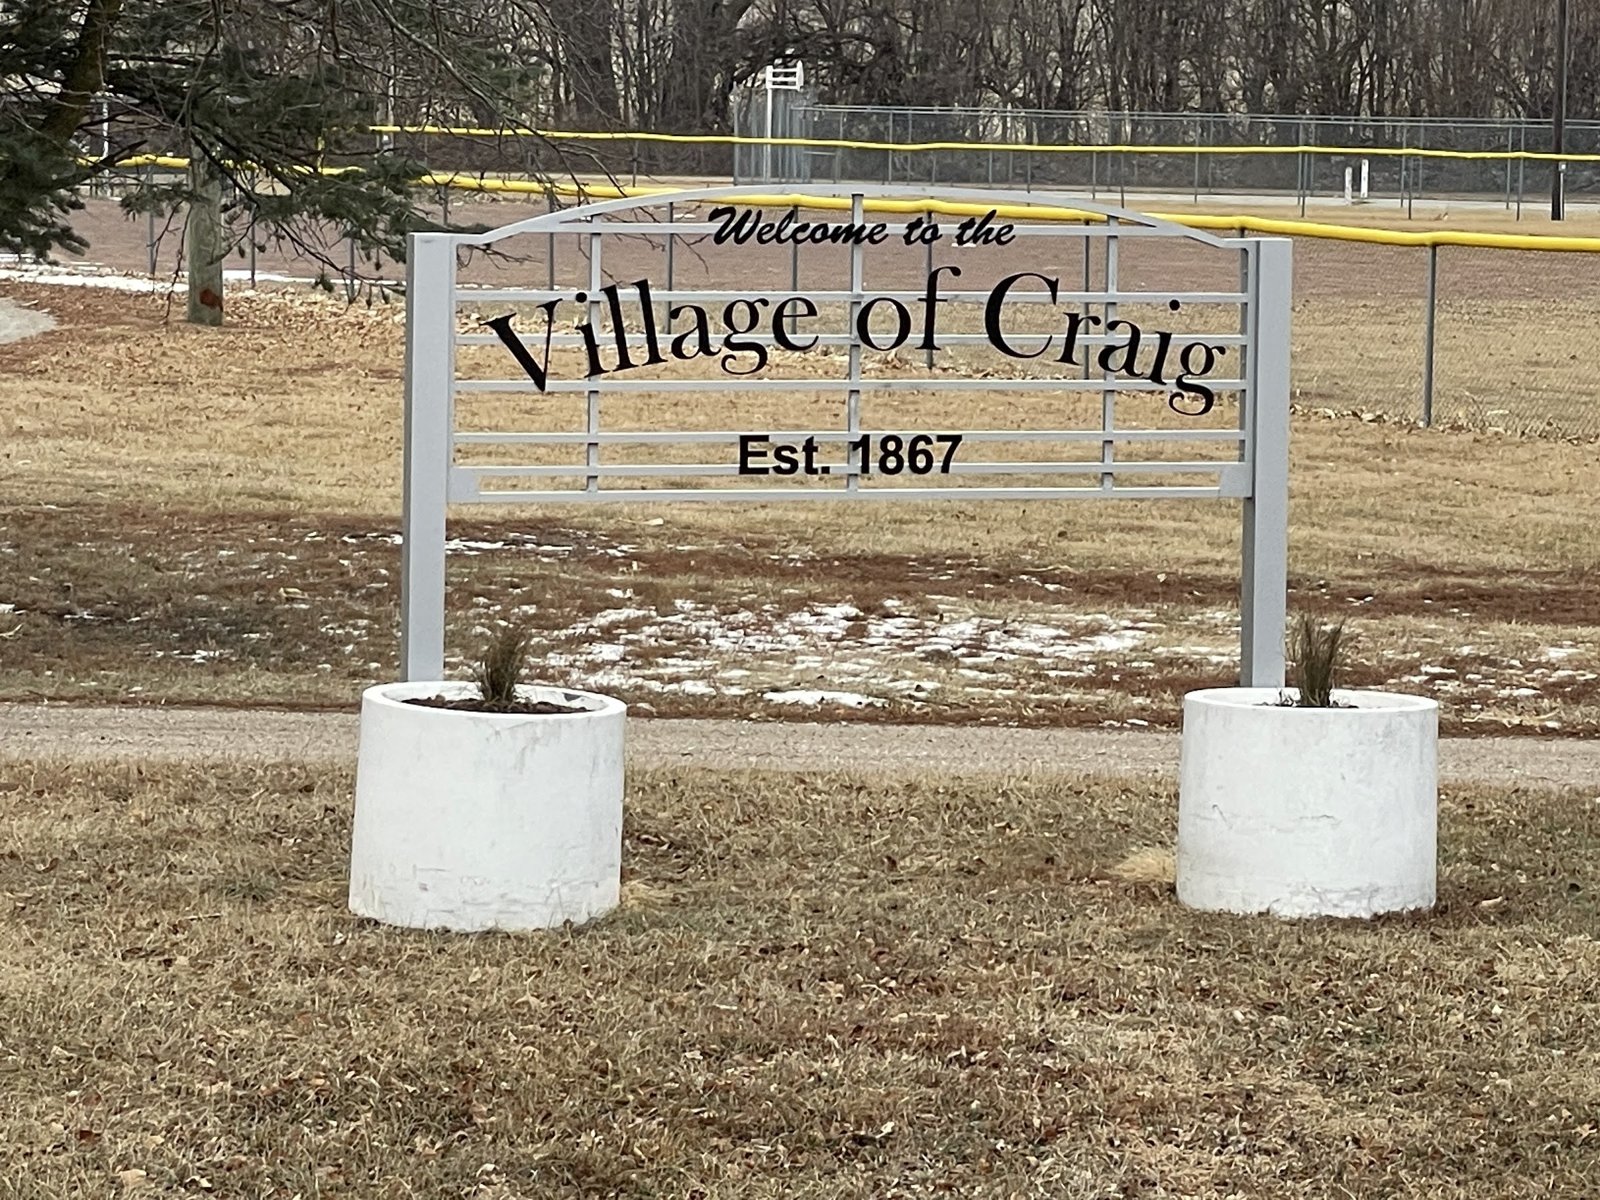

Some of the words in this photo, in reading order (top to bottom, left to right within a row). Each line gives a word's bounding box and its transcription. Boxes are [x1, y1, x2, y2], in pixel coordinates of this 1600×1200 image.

[708, 206, 888, 245] Welcome
[902, 216, 942, 245] to
[955, 209, 1016, 246] the
[481, 279, 819, 392] Village
[857, 266, 962, 351] of
[984, 273, 1226, 417] Craig
[738, 435, 831, 475] Est.
[851, 434, 963, 475] 1867
